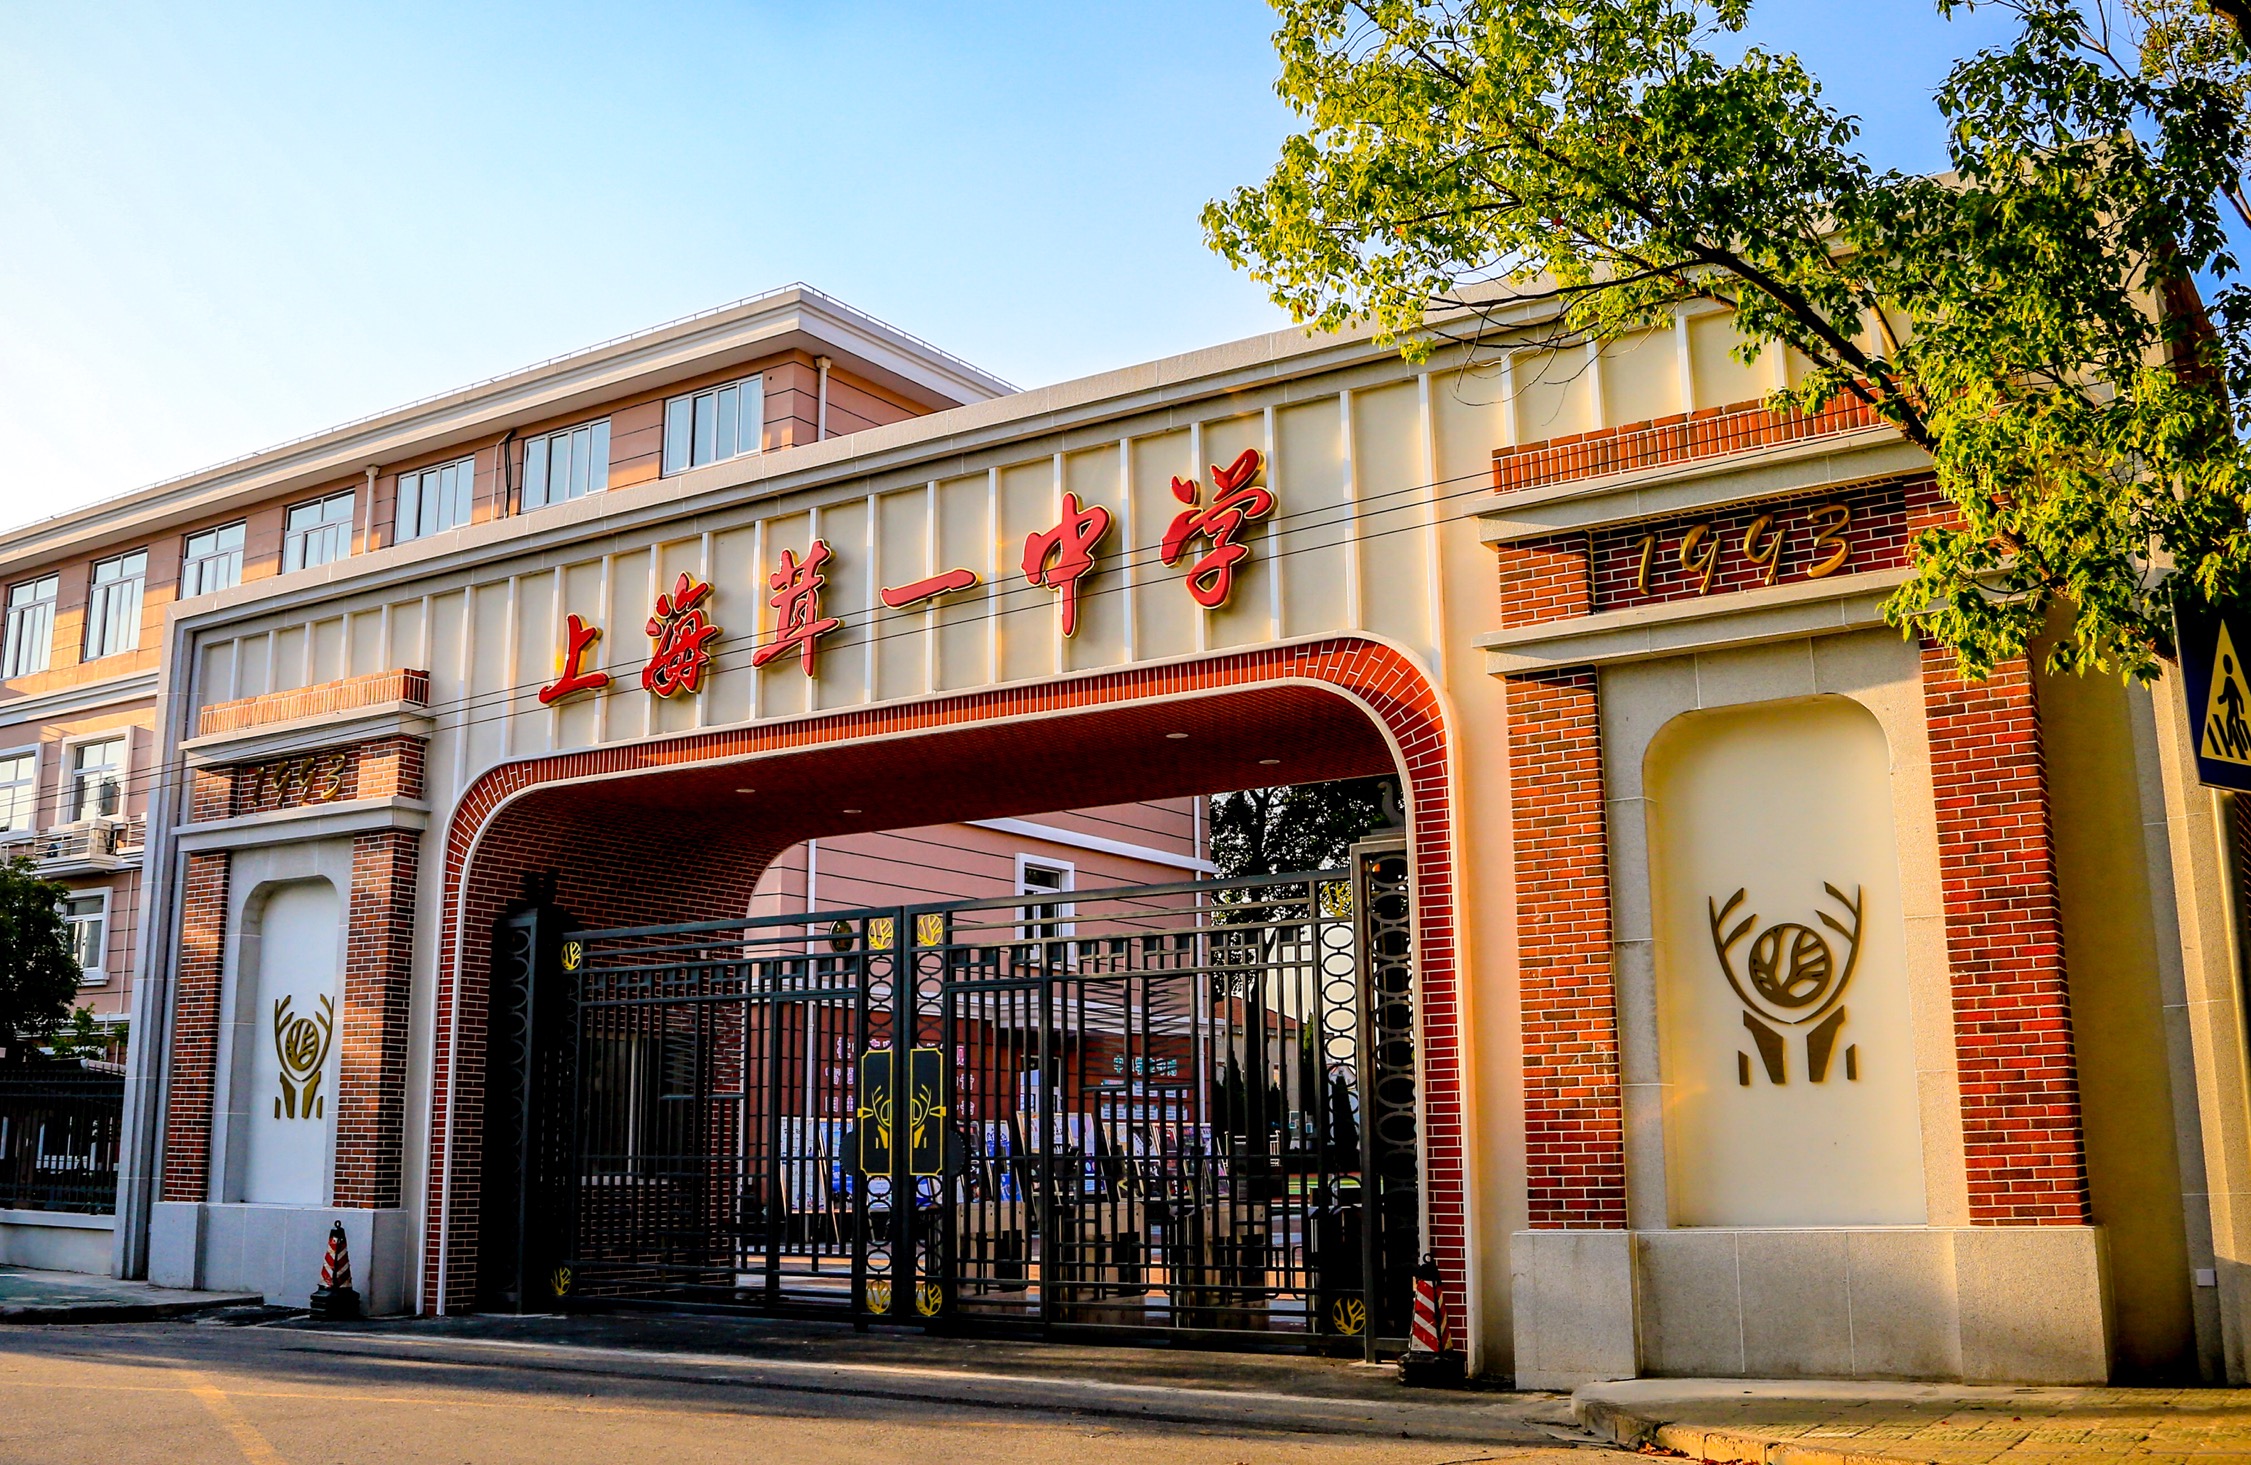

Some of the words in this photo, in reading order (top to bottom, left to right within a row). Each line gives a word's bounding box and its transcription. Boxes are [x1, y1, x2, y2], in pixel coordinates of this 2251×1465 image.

[538, 448, 1276, 705] 上海茸一中学
[1634, 502, 1851, 596] 1993
[252, 753, 346, 807] 1993
